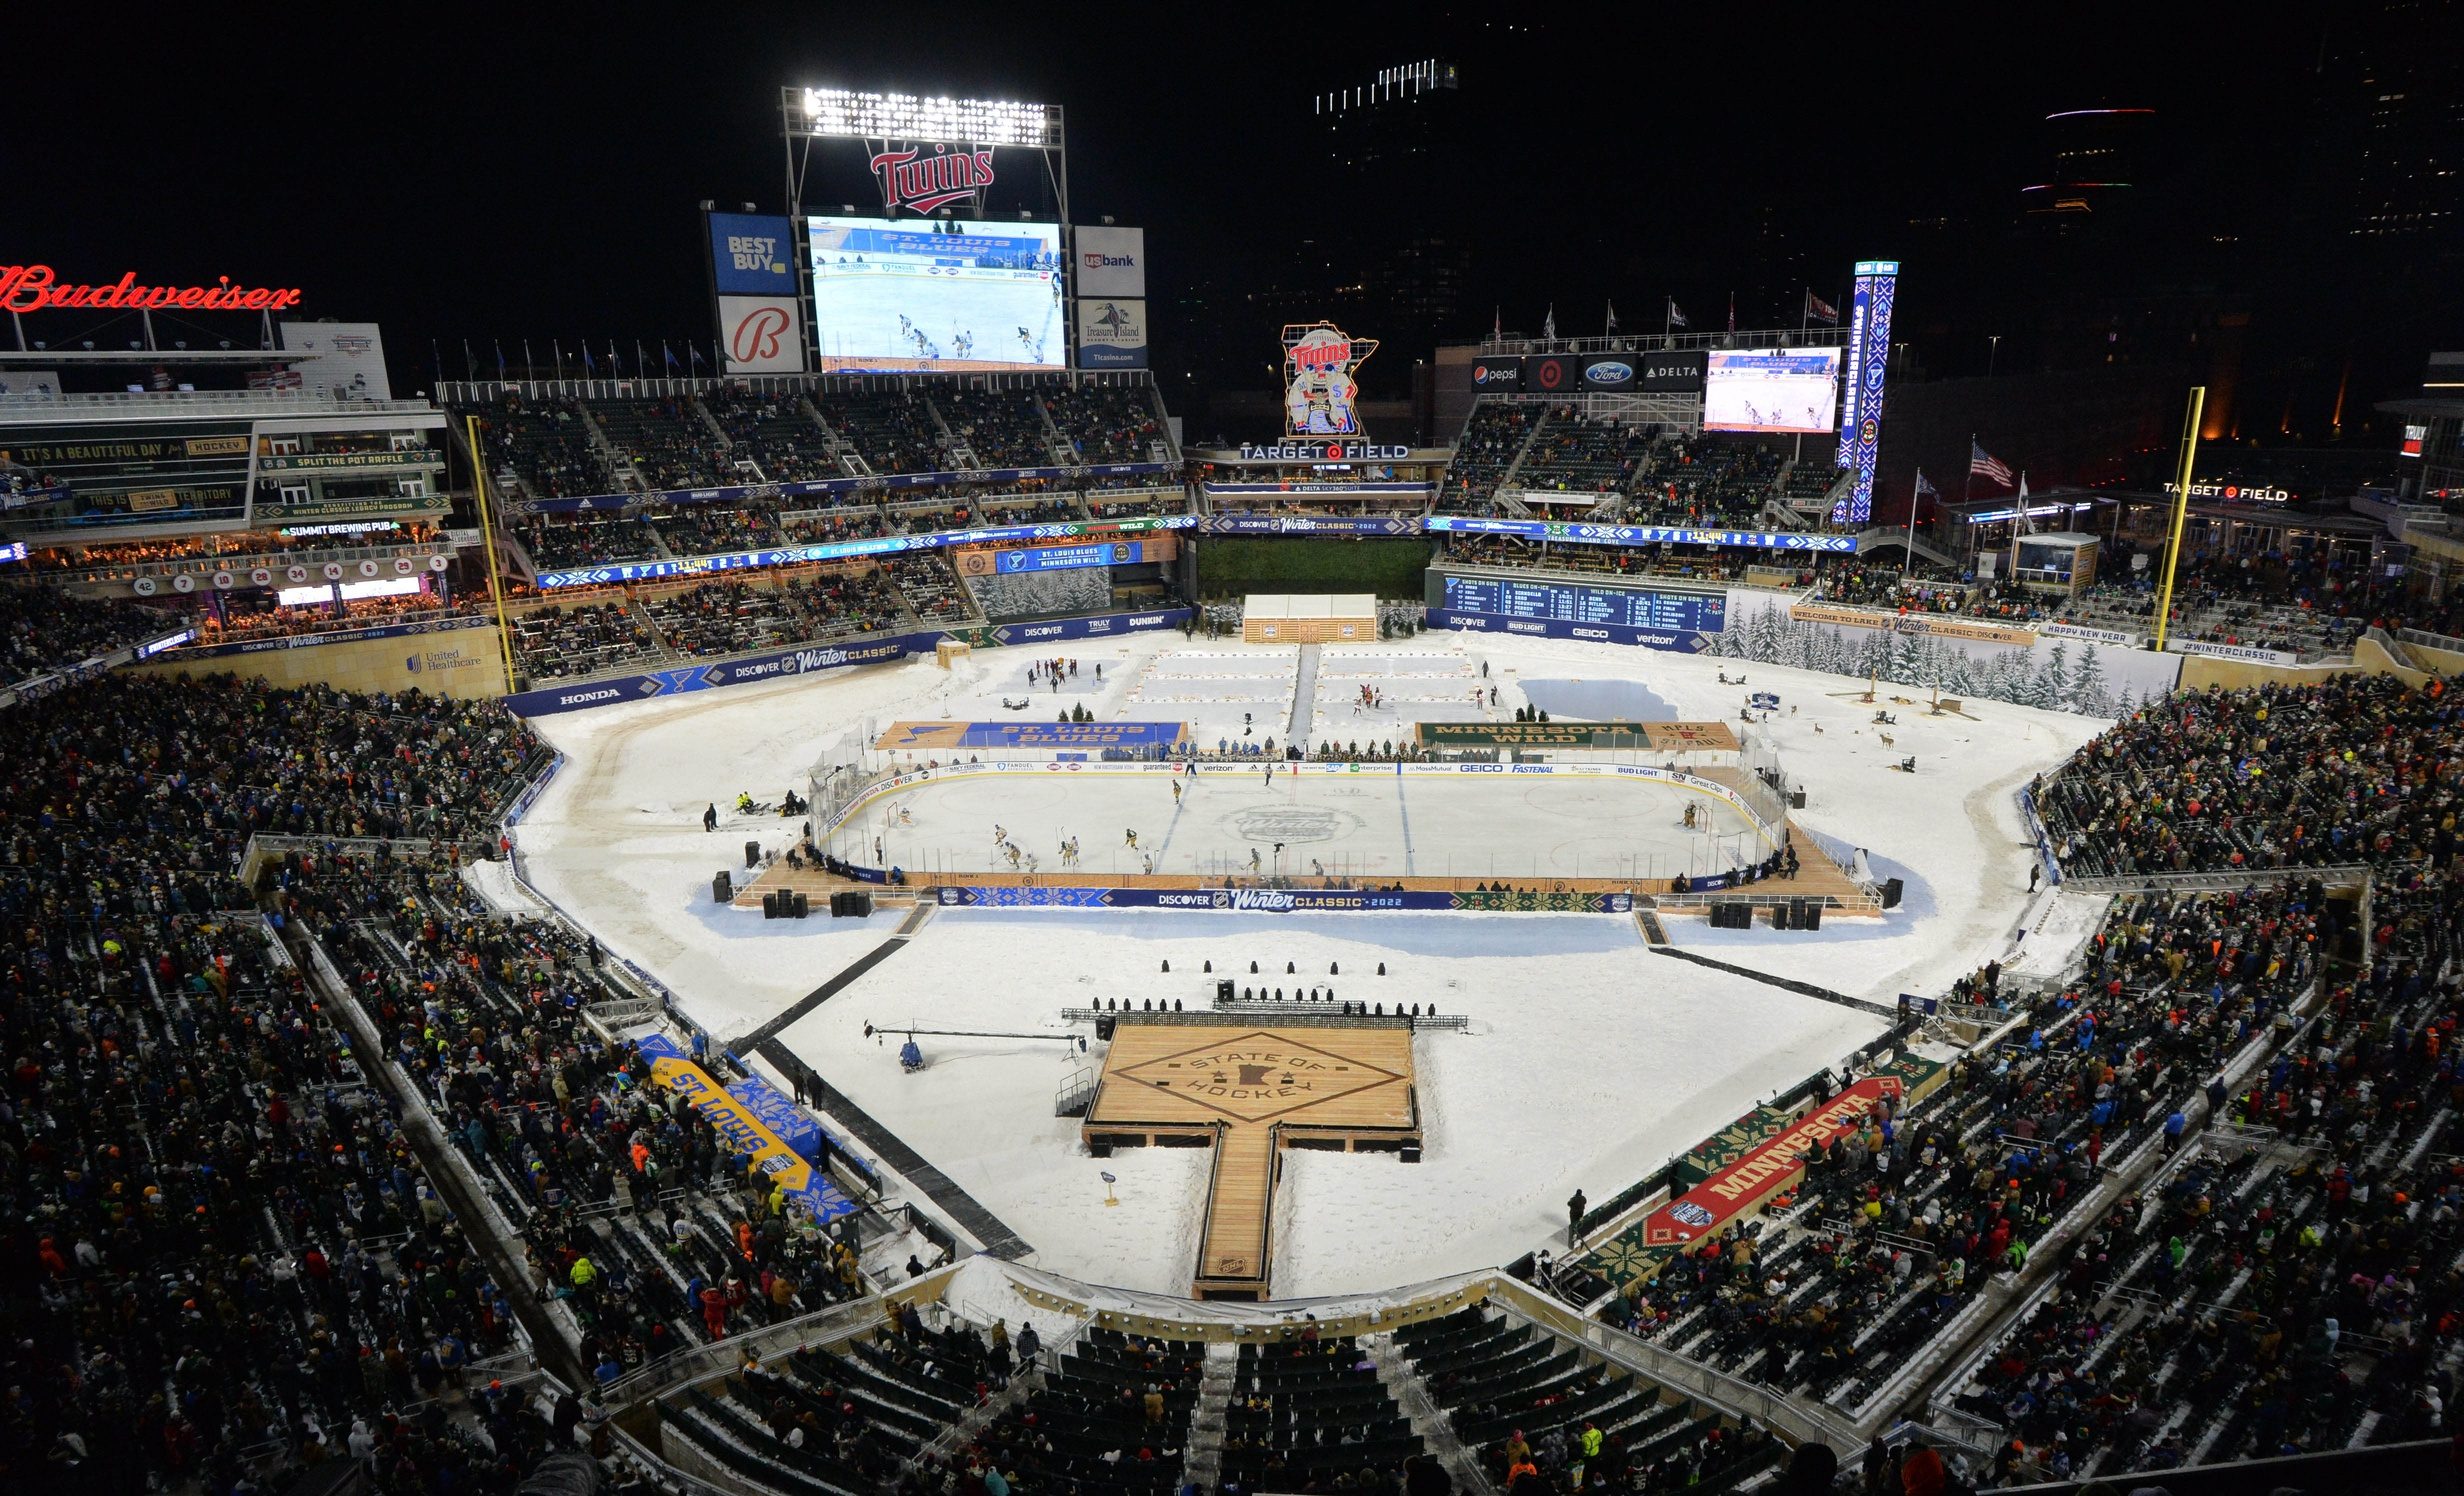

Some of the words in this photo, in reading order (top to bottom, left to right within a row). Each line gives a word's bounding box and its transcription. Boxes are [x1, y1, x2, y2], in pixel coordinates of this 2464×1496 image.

[870, 144, 994, 208] Twins
[728, 236, 776, 255] BEST
[930, 235, 1011, 247] LOUIS
[897, 242, 989, 253] BLUES
[733, 253, 774, 271] BUY
[0, 265, 301, 312] Budweiser
[1085, 325, 1114, 338] Treasure
[1118, 325, 1139, 338] Island
[1289, 341, 1351, 376] Twins
[1844, 304, 1865, 427] #WINTERCLASSIC
[1489, 367, 1517, 382] pepsi
[1594, 365, 1623, 379] Ford
[1659, 367, 1698, 377] DELTA
[23, 448, 50, 461] IT'S
[56, 447, 64, 460] A
[67, 445, 138, 459] BEAUTIFUL
[141, 443, 162, 457] DAY
[195, 441, 240, 451] HOCKEY
[1240, 446, 1324, 460] TARGET
[1346, 445, 1408, 459] FIELD
[298, 457, 324, 467] SPLIT
[326, 456, 346, 466] THE
[348, 456, 366, 465] POT
[369, 454, 404, 464] RAFFLE
[90, 495, 113, 506] THIS
[116, 494, 127, 505] IS
[178, 488, 232, 501] TERRITORY
[2240, 488, 2288, 502] FIELD
[293, 508, 320, 516] WINTER
[321, 506, 350, 514] CLASSIC
[352, 504, 378, 512] LEGACY
[290, 525, 327, 537] SUMMIT
[328, 523, 371, 535] BREWING
[372, 521, 391, 532] PUB
[1119, 522, 1144, 530] WILD
[1280, 518, 1316, 532] Winter
[1316, 522, 1354, 530] CLASSIC
[366, 564, 372, 573] 6
[398, 562, 410, 571] 29
[435, 559, 441, 568] 3
[1041, 558, 1081, 567] MINNESOTA
[256, 572, 268, 582] 28
[291, 569, 304, 579] 34
[328, 566, 340, 576] 14
[180, 579, 187, 589] 7
[218, 576, 230, 585] 10
[139, 582, 152, 592] 42
[1088, 619, 1110, 629] TRULY
[1129, 615, 1164, 627] DUNKIN'
[1450, 616, 1486, 627] DISCOVER
[1509, 622, 1523, 630] BUD
[1523, 623, 1545, 632] LIGHT
[1793, 610, 1838, 622] WELCOME
[1839, 615, 1852, 623] TO
[1853, 617, 1879, 626] LAKE
[1893, 617, 1931, 632] Winter
[1931, 626, 1973, 637] CLASSIC
[1977, 630, 2012, 641] DISCOVER
[1025, 626, 1062, 637] DISCOVER
[1572, 627, 1609, 639] GEICO
[2048, 624, 2078, 637] HAPPY
[2080, 628, 2100, 639] NEW
[2101, 631, 2127, 642] YEAR
[242, 641, 274, 651] DISCOVER
[288, 635, 326, 649] Winter
[325, 632, 363, 642] CLASSIC
[1636, 633, 1673, 645] verizon
[426, 650, 460, 662] United
[2184, 642, 2277, 661] #WINTERCLASSIC
[427, 656, 481, 672] Healthcare
[736, 661, 780, 678] DISCOVER
[796, 648, 848, 674] Winter
[847, 644, 898, 660] CLASSIC
[560, 687, 621, 705] HONDA
[1001, 726, 1044, 734] ST.
[1055, 725, 1145, 734] LOUIS
[1434, 725, 1632, 735] MINNESOTA
[1017, 734, 1120, 743] BLUES
[1492, 735, 1578, 744] WILD
[963, 763, 986, 771] FEDERAL
[1143, 763, 1172, 772] guaranteed
[1326, 764, 1341, 772] SAP
[1460, 764, 1504, 773] GEICO
[1512, 764, 1554, 774] FASTENAL
[1617, 767, 1634, 776] BUD
[1634, 769, 1658, 778] LIGHT
[880, 775, 913, 791] DISCOVER
[1690, 776, 1708, 789] Great
[1707, 781, 1724, 794] Clips
[1158, 894, 1209, 905] DISCOVER
[1231, 889, 1294, 912] Winter
[1294, 896, 1362, 907] CLASSIC
[1371, 897, 1402, 906] 2022
[1190, 1052, 1283, 1070] STATE
[1288, 1057, 1327, 1073] OF
[1187, 1080, 1313, 1100] HOCKEY
[671, 1072, 710, 1101] ST.
[697, 1098, 769, 1154] LOUIS
[1709, 1092, 1879, 1201] MINNESOTA
